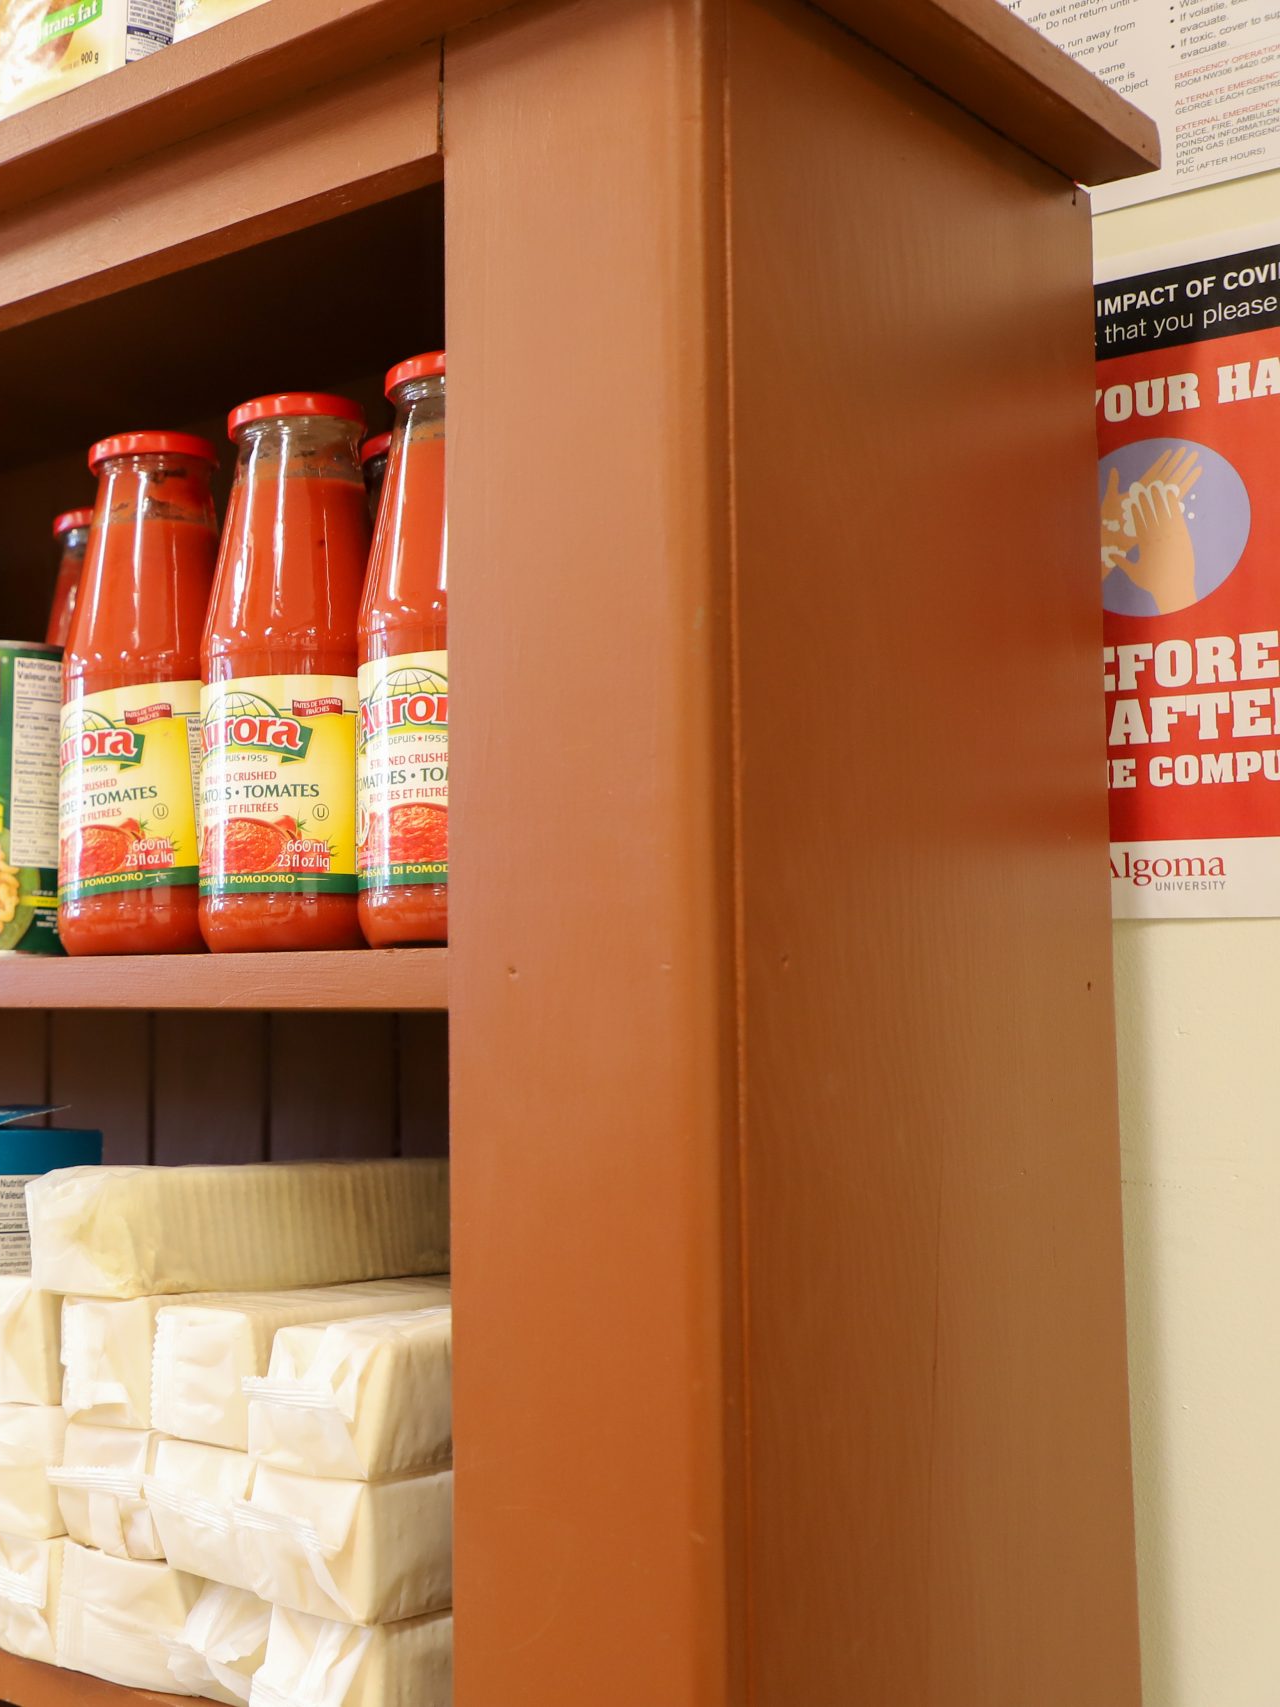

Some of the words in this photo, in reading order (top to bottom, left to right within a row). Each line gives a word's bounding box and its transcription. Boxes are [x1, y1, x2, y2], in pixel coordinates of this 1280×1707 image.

[78, 0, 99, 22] fat
[1027, 12, 1047, 24] safe
[1049, 5, 1066, 17] exit
[1046, 20, 1060, 31] Do
[1062, 14, 1078, 26] not
[1079, 5, 1108, 20] return
[1179, 13, 1230, 34] evacuate.
[1219, 20, 1248, 36] cover
[1251, 16, 1262, 26] to
[1067, 37, 1083, 49] run
[1085, 28, 1111, 43] away
[1113, 20, 1136, 34] from
[1096, 37, 1119, 53] your
[1180, 39, 1230, 60] evacuate.
[80, 51, 94, 66] 900
[94, 51, 99, 65] g
[1098, 61, 1126, 76] same
[1126, 70, 1136, 80] is
[1174, 57, 1231, 82] EMERGENCY
[1119, 78, 1149, 95] object
[1174, 75, 1201, 90] ROOM
[1174, 84, 1226, 107] ALTERNATE
[1175, 98, 1214, 116] GEORGE
[1214, 90, 1245, 105] LEACH
[1175, 114, 1221, 133] EXTERNAL
[1222, 97, 1280, 121] EMERGENCY
[1175, 132, 1216, 150] POINSON
[1217, 115, 1280, 139] INFORMATION
[1176, 144, 1204, 159] UNION
[1205, 138, 1225, 151] GAS
[1176, 165, 1195, 176] PUC
[1196, 155, 1229, 172] (AFTER
[1230, 146, 1267, 162] HOURS)
[1176, 156, 1195, 168] PUC
[1096, 283, 1179, 318] IMPACT
[1185, 275, 1217, 299] OF
[1222, 260, 1280, 291] COVI
[1104, 317, 1148, 345] that
[1152, 310, 1194, 339] you
[1202, 295, 1279, 329] please
[388, 734, 417, 746] DEPUIS
[247, 753, 269, 763] 1955
[233, 770, 277, 783] CRUSHED
[89, 785, 158, 808] TOMATES
[243, 783, 320, 799] TOMATES
[402, 788, 414, 799] ET
[228, 803, 237, 813] ET
[239, 801, 279, 814] FILTRÉES
[132, 839, 156, 852] 660
[156, 838, 173, 850] mL
[287, 839, 312, 853] 660
[313, 839, 331, 853] mL
[125, 854, 138, 867] 23
[147, 854, 160, 864] oz
[161, 851, 175, 865] liq
[278, 854, 291, 867] 23
[301, 856, 315, 868] oz
[315, 854, 331, 871] liq
[230, 873, 295, 884] POMODORO
[392, 865, 403, 875] DI
[84, 871, 144, 888] POMODORO
[1154, 880, 1227, 893] UNIVERSITY
